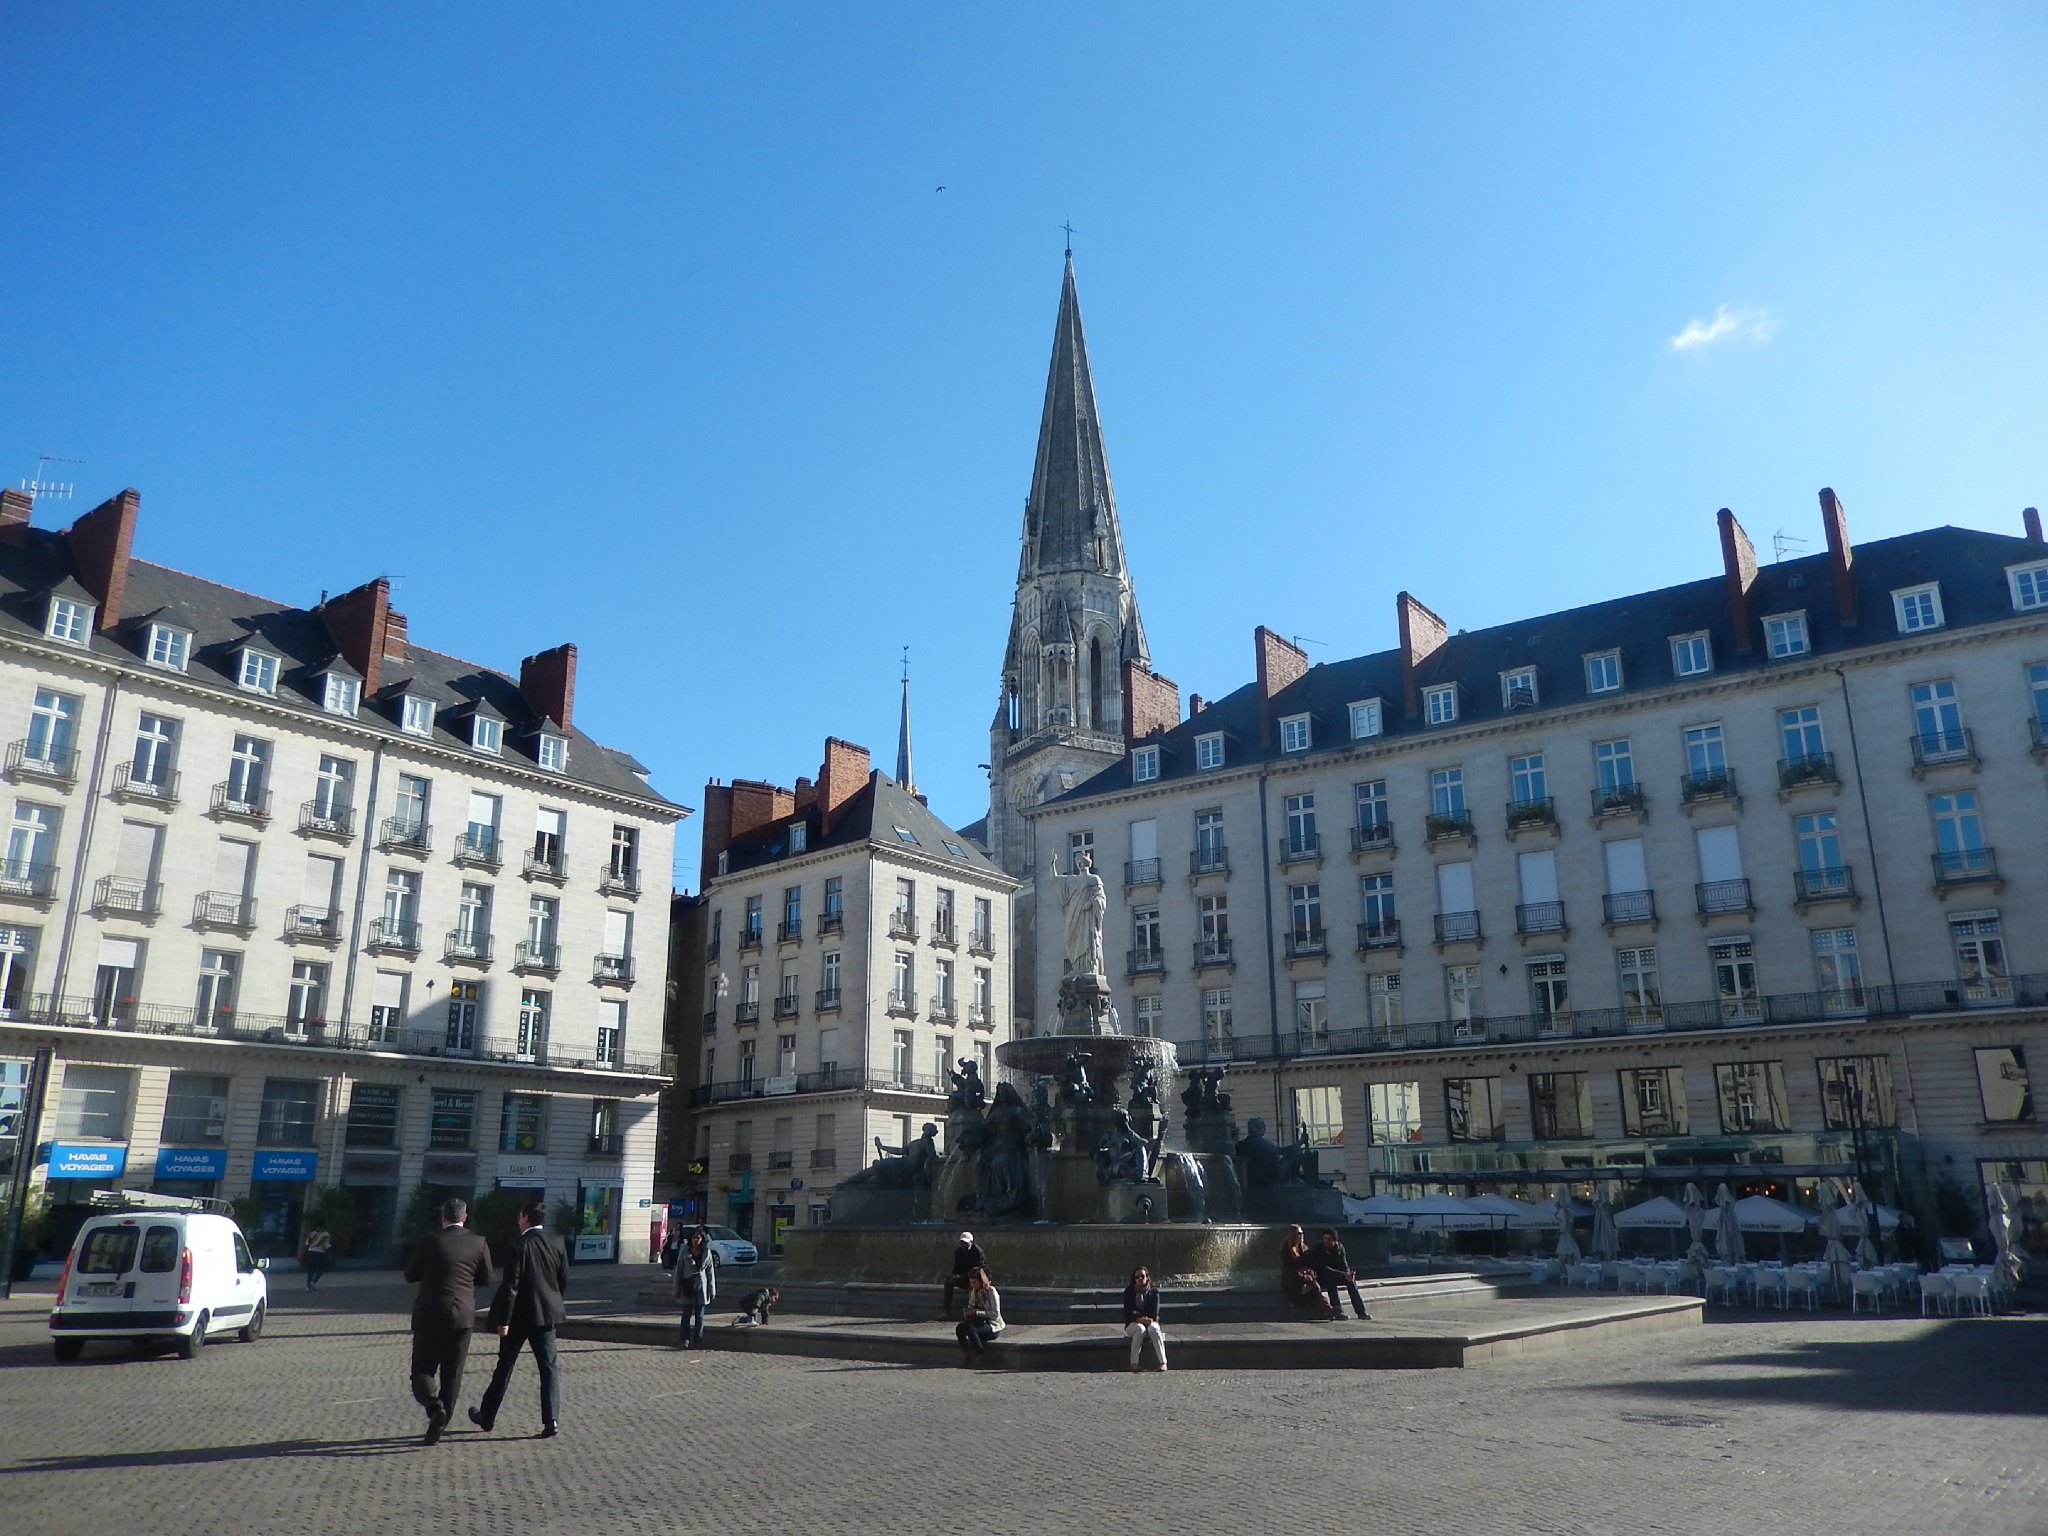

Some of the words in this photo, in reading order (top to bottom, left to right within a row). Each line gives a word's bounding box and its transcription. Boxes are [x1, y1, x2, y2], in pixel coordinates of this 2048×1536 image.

[518, 1012, 527, 1054] GESTION
[68, 1153, 108, 1161] HAVAS
[174, 1155, 209, 1163] HAVAS
[59, 1163, 114, 1171] VOYAGES
[166, 1165, 215, 1173] VOYAGES
